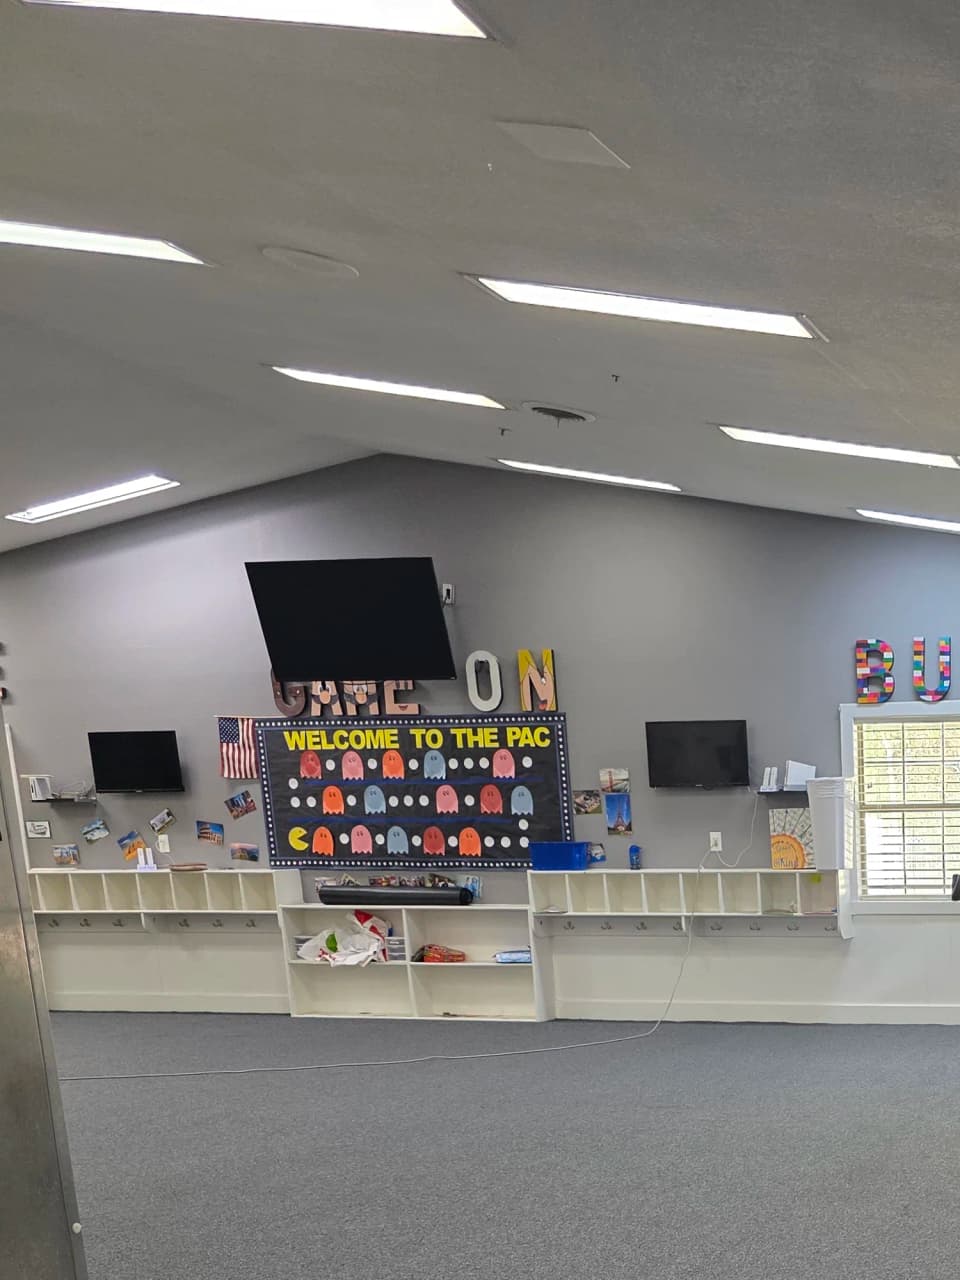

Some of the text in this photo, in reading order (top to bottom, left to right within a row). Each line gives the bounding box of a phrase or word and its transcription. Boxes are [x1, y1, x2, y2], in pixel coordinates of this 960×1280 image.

[465, 648, 558, 713] ON
[283, 726, 551, 751] WELCOME TO THE PAC
